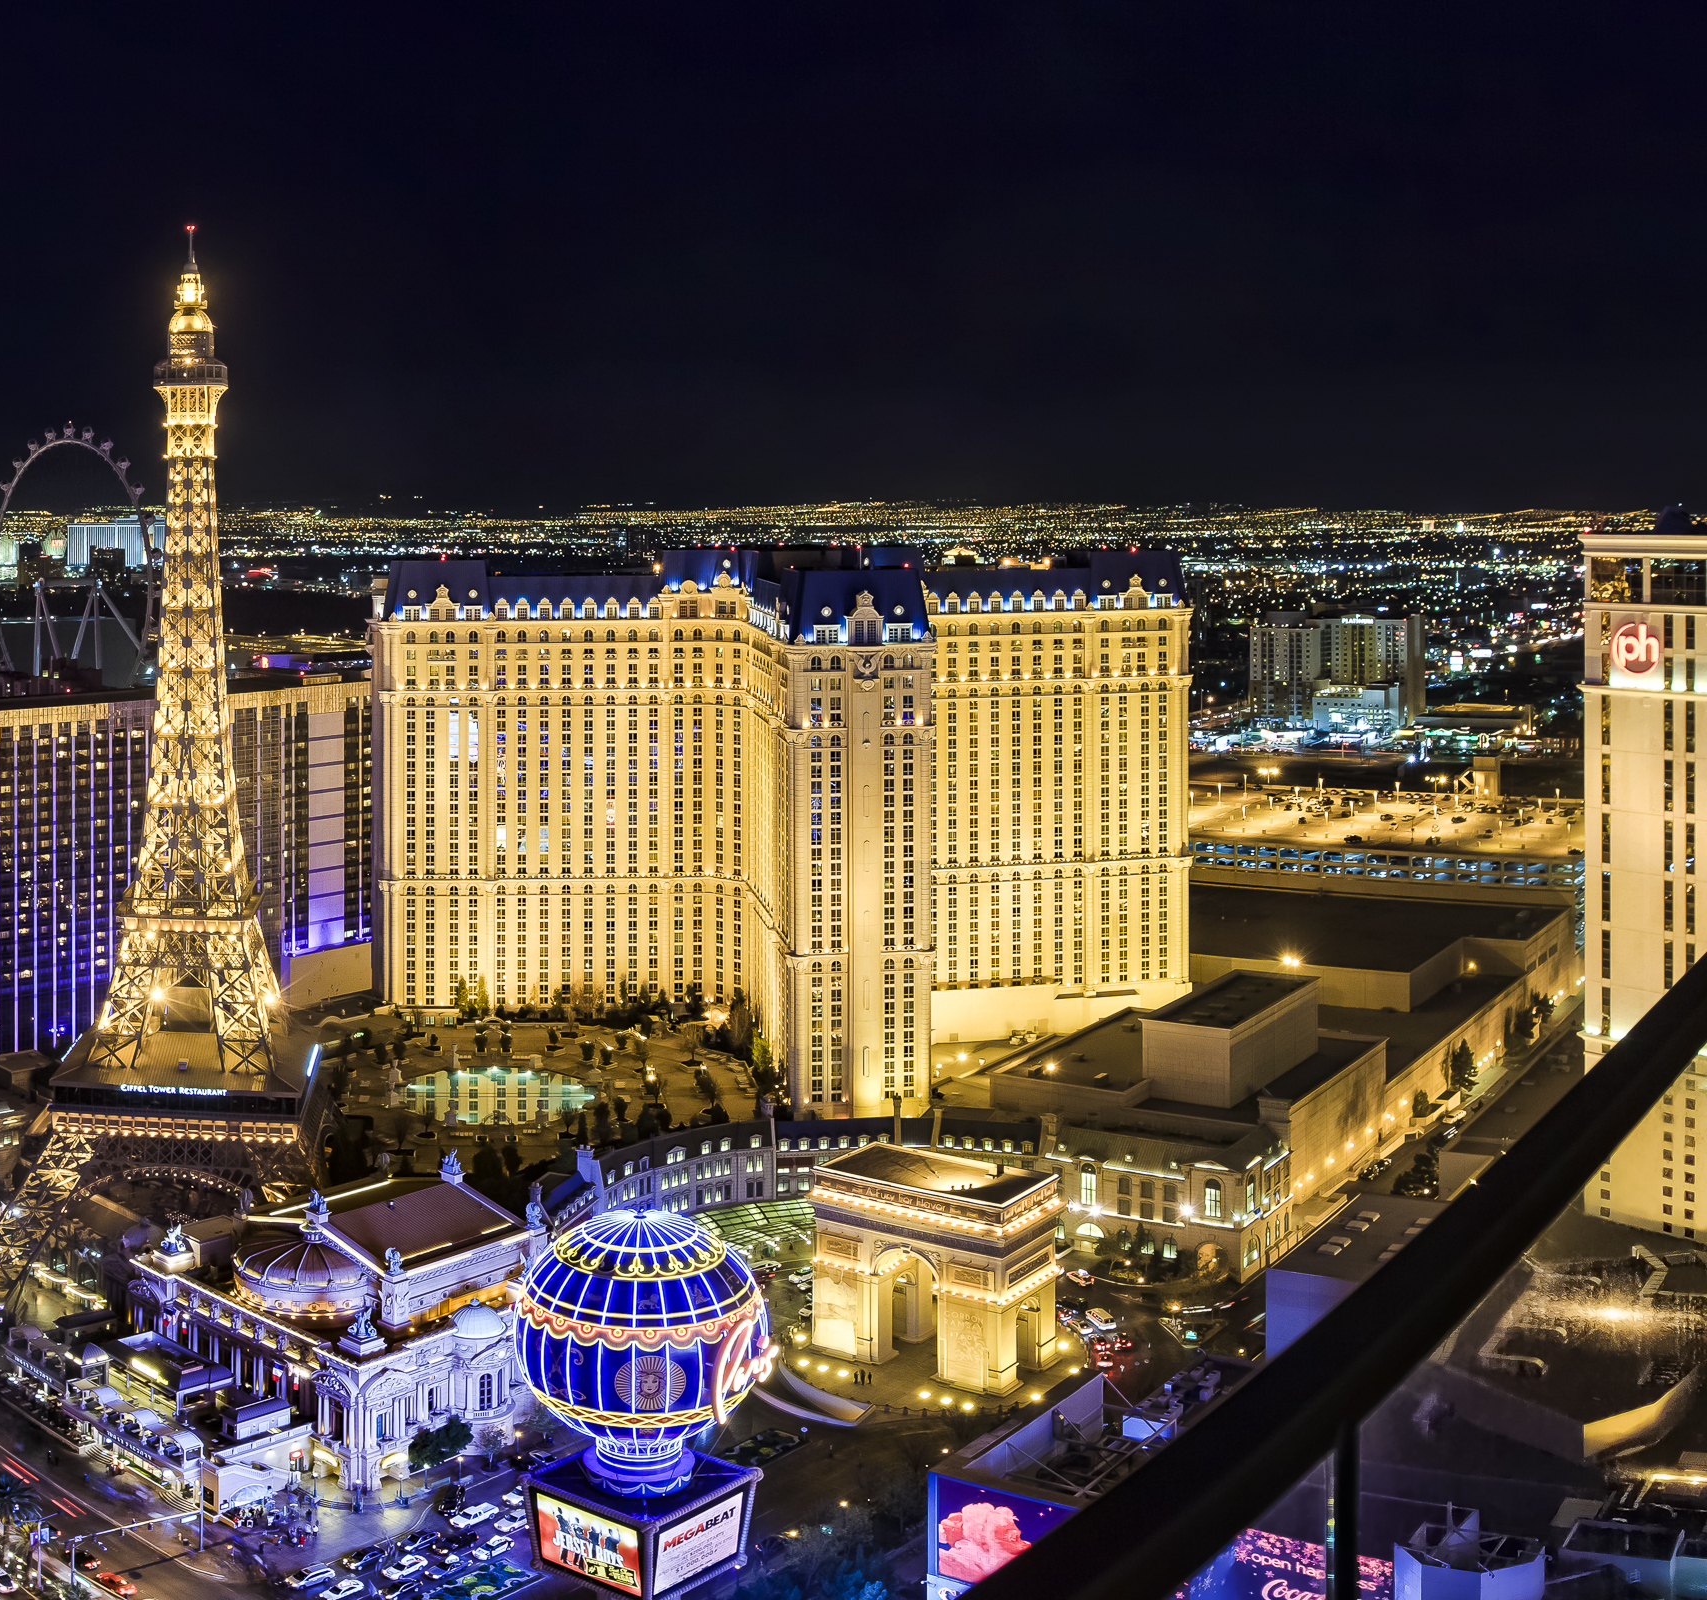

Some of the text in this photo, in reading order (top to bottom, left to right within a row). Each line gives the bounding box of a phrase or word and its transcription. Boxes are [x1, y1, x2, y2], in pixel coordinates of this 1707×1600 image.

[714, 1319, 779, 1424] Paris
[552, 1529, 624, 1568] JERSEY BOYS
[662, 1505, 736, 1553] MEGABEAT
[1250, 1552, 1292, 1571] open
